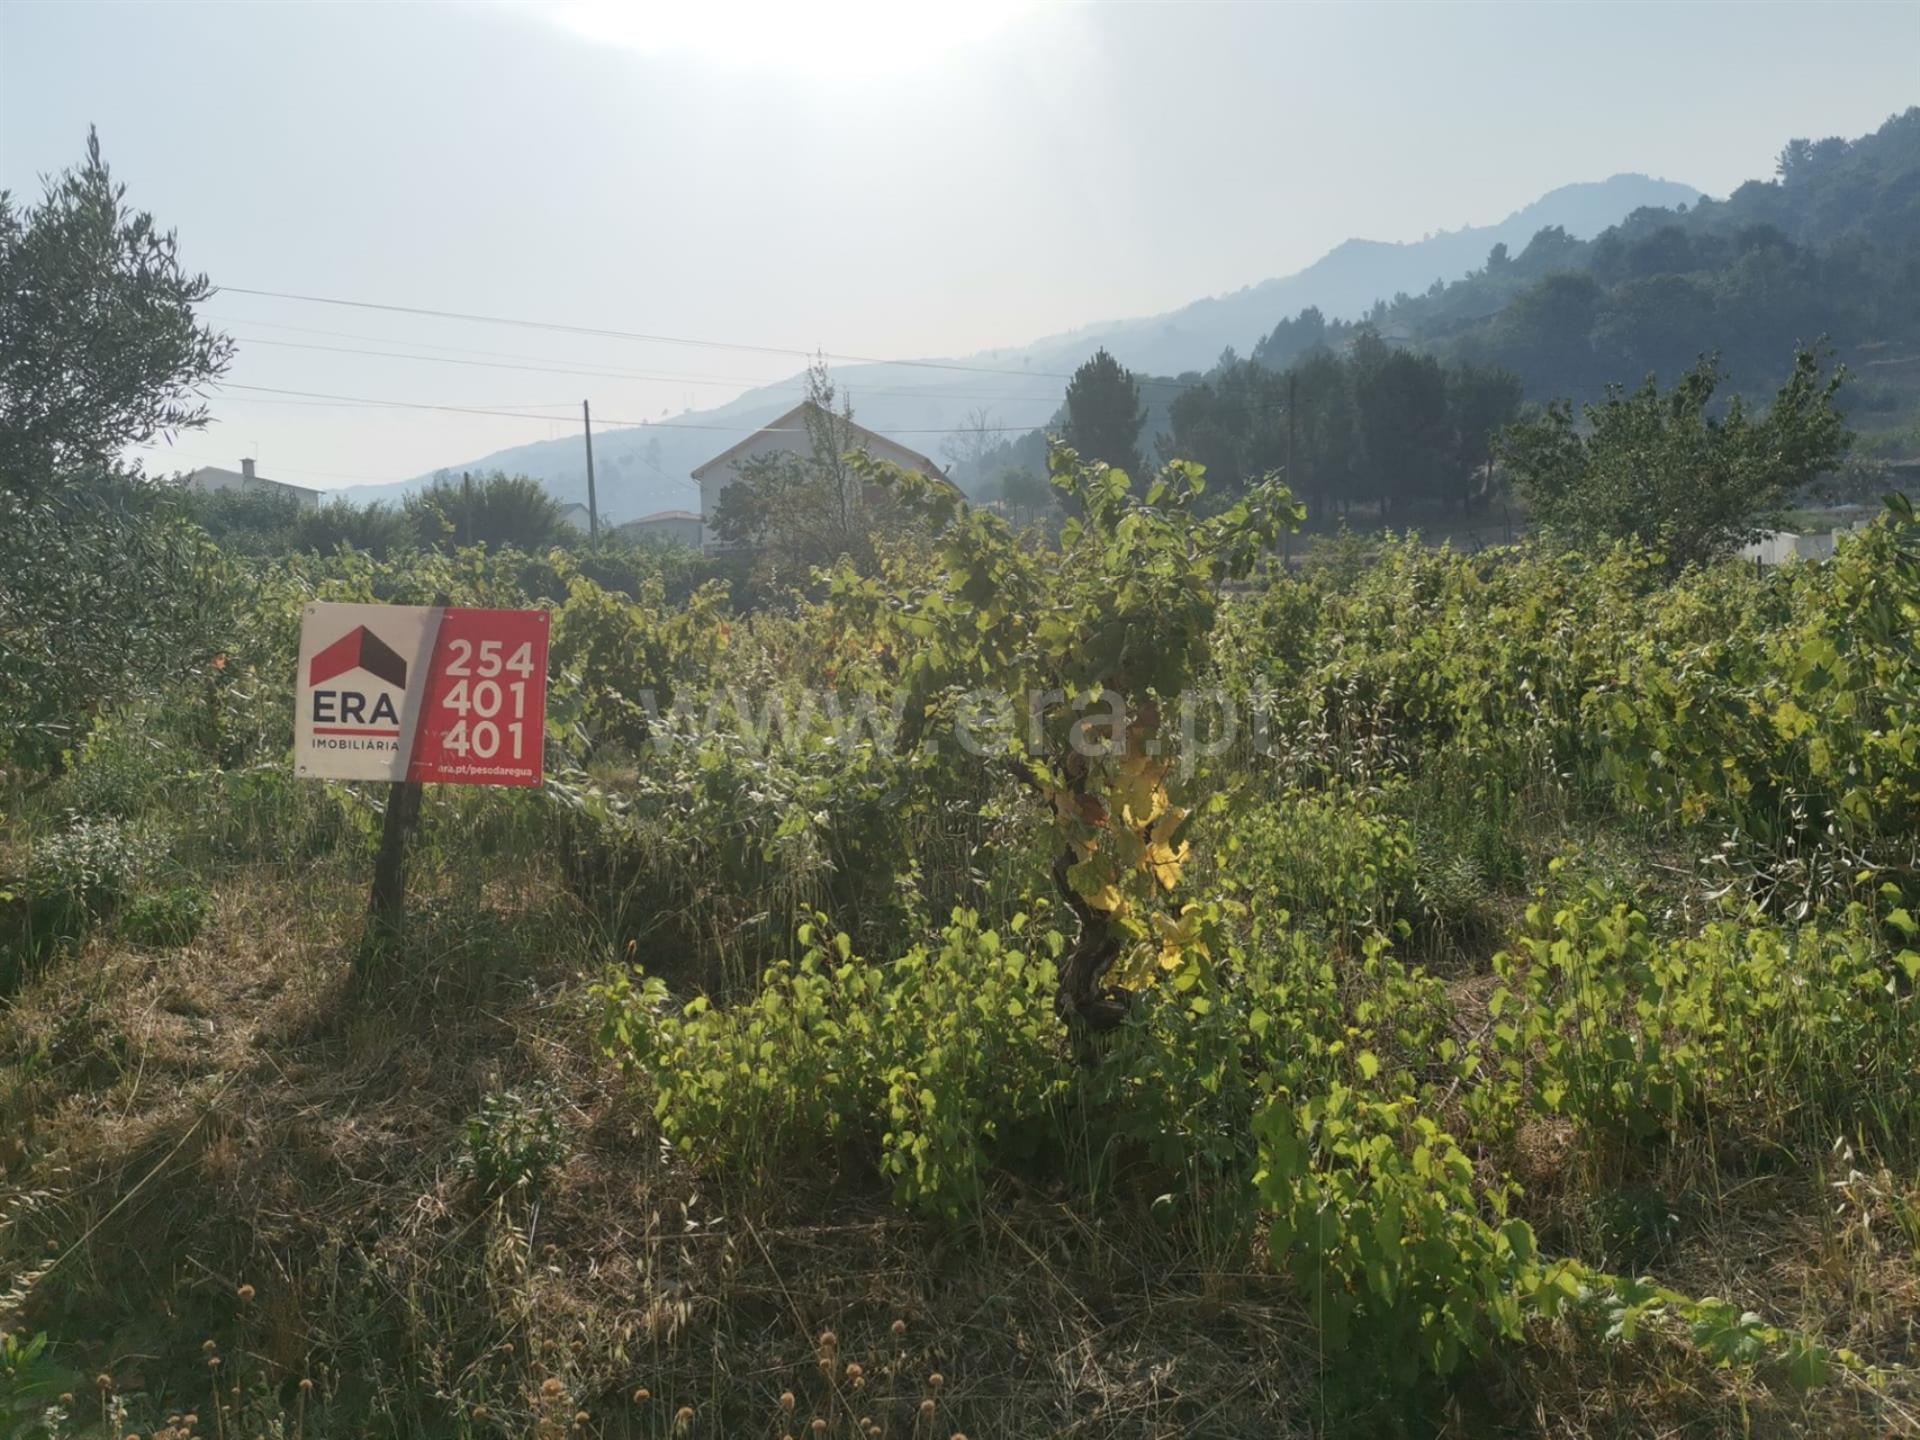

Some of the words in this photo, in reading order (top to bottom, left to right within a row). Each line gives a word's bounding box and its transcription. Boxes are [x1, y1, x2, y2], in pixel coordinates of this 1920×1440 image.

[446, 639, 534, 678] 254
[313, 691, 399, 725] ERA
[442, 679, 525, 719] 401
[442, 719, 523, 760] 401
